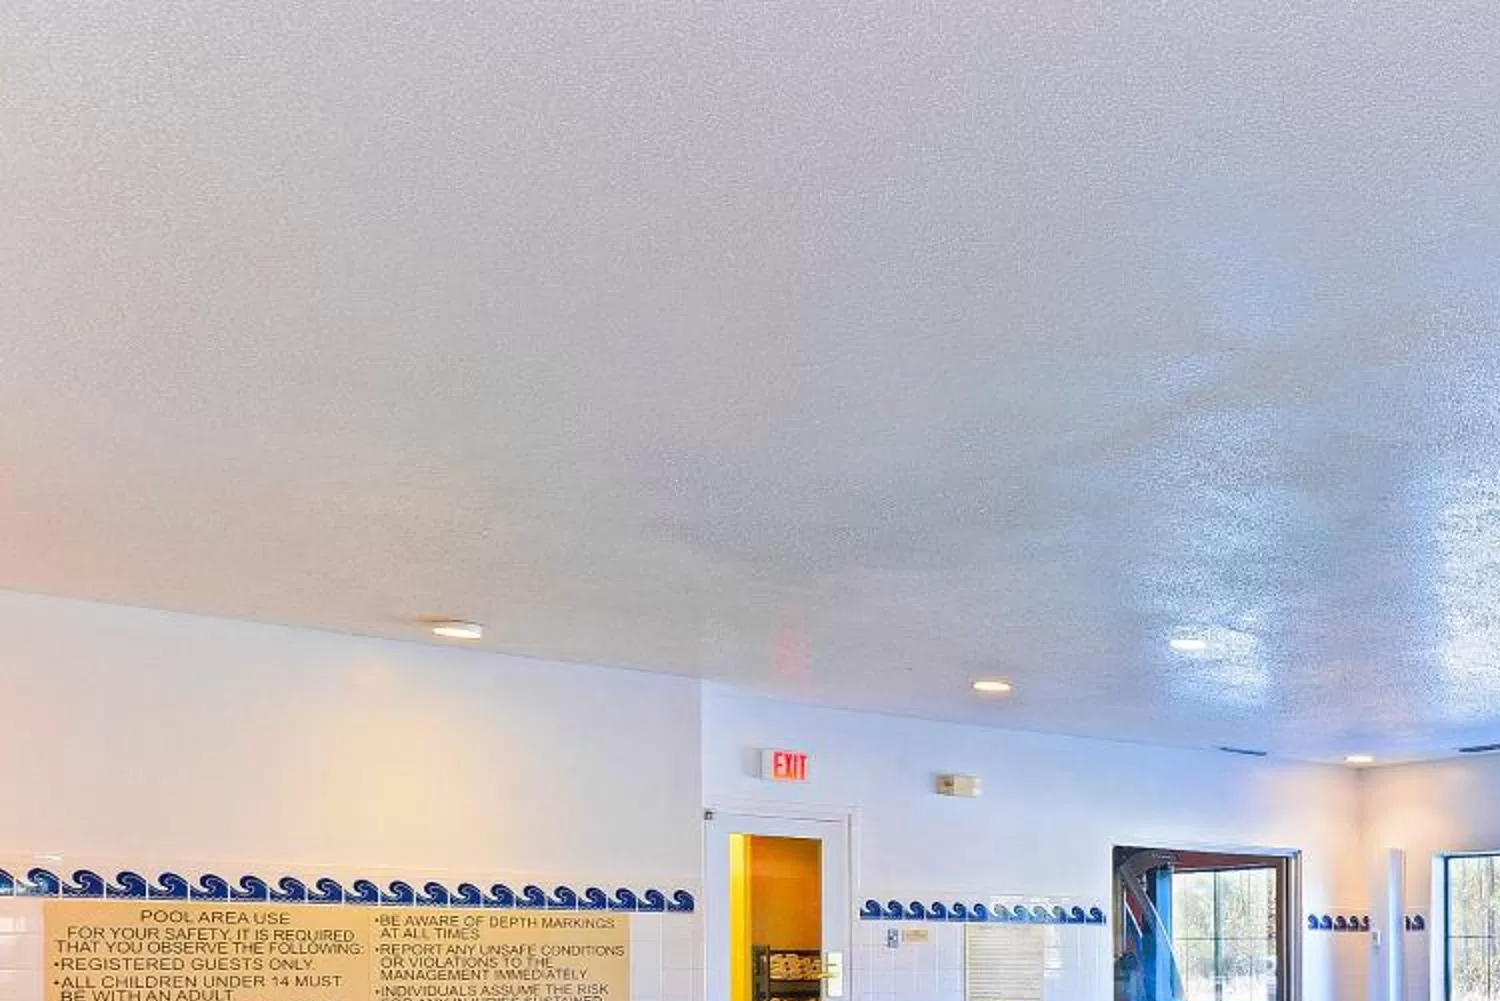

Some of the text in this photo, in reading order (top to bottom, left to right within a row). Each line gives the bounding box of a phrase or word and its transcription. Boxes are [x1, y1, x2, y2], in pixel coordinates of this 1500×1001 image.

[774, 751, 809, 780] EXIT
[140, 910, 290, 924] POOL AREA USE
[380, 914, 615, 929] BE AWARE OF DEPTH MARKINGS
[68, 927, 104, 939] FOR
[113, 928, 159, 940] YOUR
[236, 930, 249, 941] IT
[255, 930, 268, 941] IS
[273, 930, 354, 942] REQUIRED
[380, 928, 399, 939] AT
[404, 928, 430, 939] ALL
[57, 940, 98, 953] THAT
[106, 941, 142, 953] YOU
[148, 942, 225, 954] OBSERVE
[233, 943, 264, 955] THE
[380, 944, 625, 957] REPORT ANY UNSAFE CONDITIONS
[62, 958, 184, 970] REGISTERED
[191, 958, 263, 970] GUESTS
[380, 957, 552, 968] OR VIOLATIONS TO THE
[381, 970, 489, 981] MANAGEMENT
[62, 976, 342, 988] ALL CHILDREN UNDER 14 MUST
[93, 991, 142, 1001] WITH
[147, 991, 170, 1001] AN
[381, 984, 608, 996] INDIVIDUALS ASSUME THE RISK
